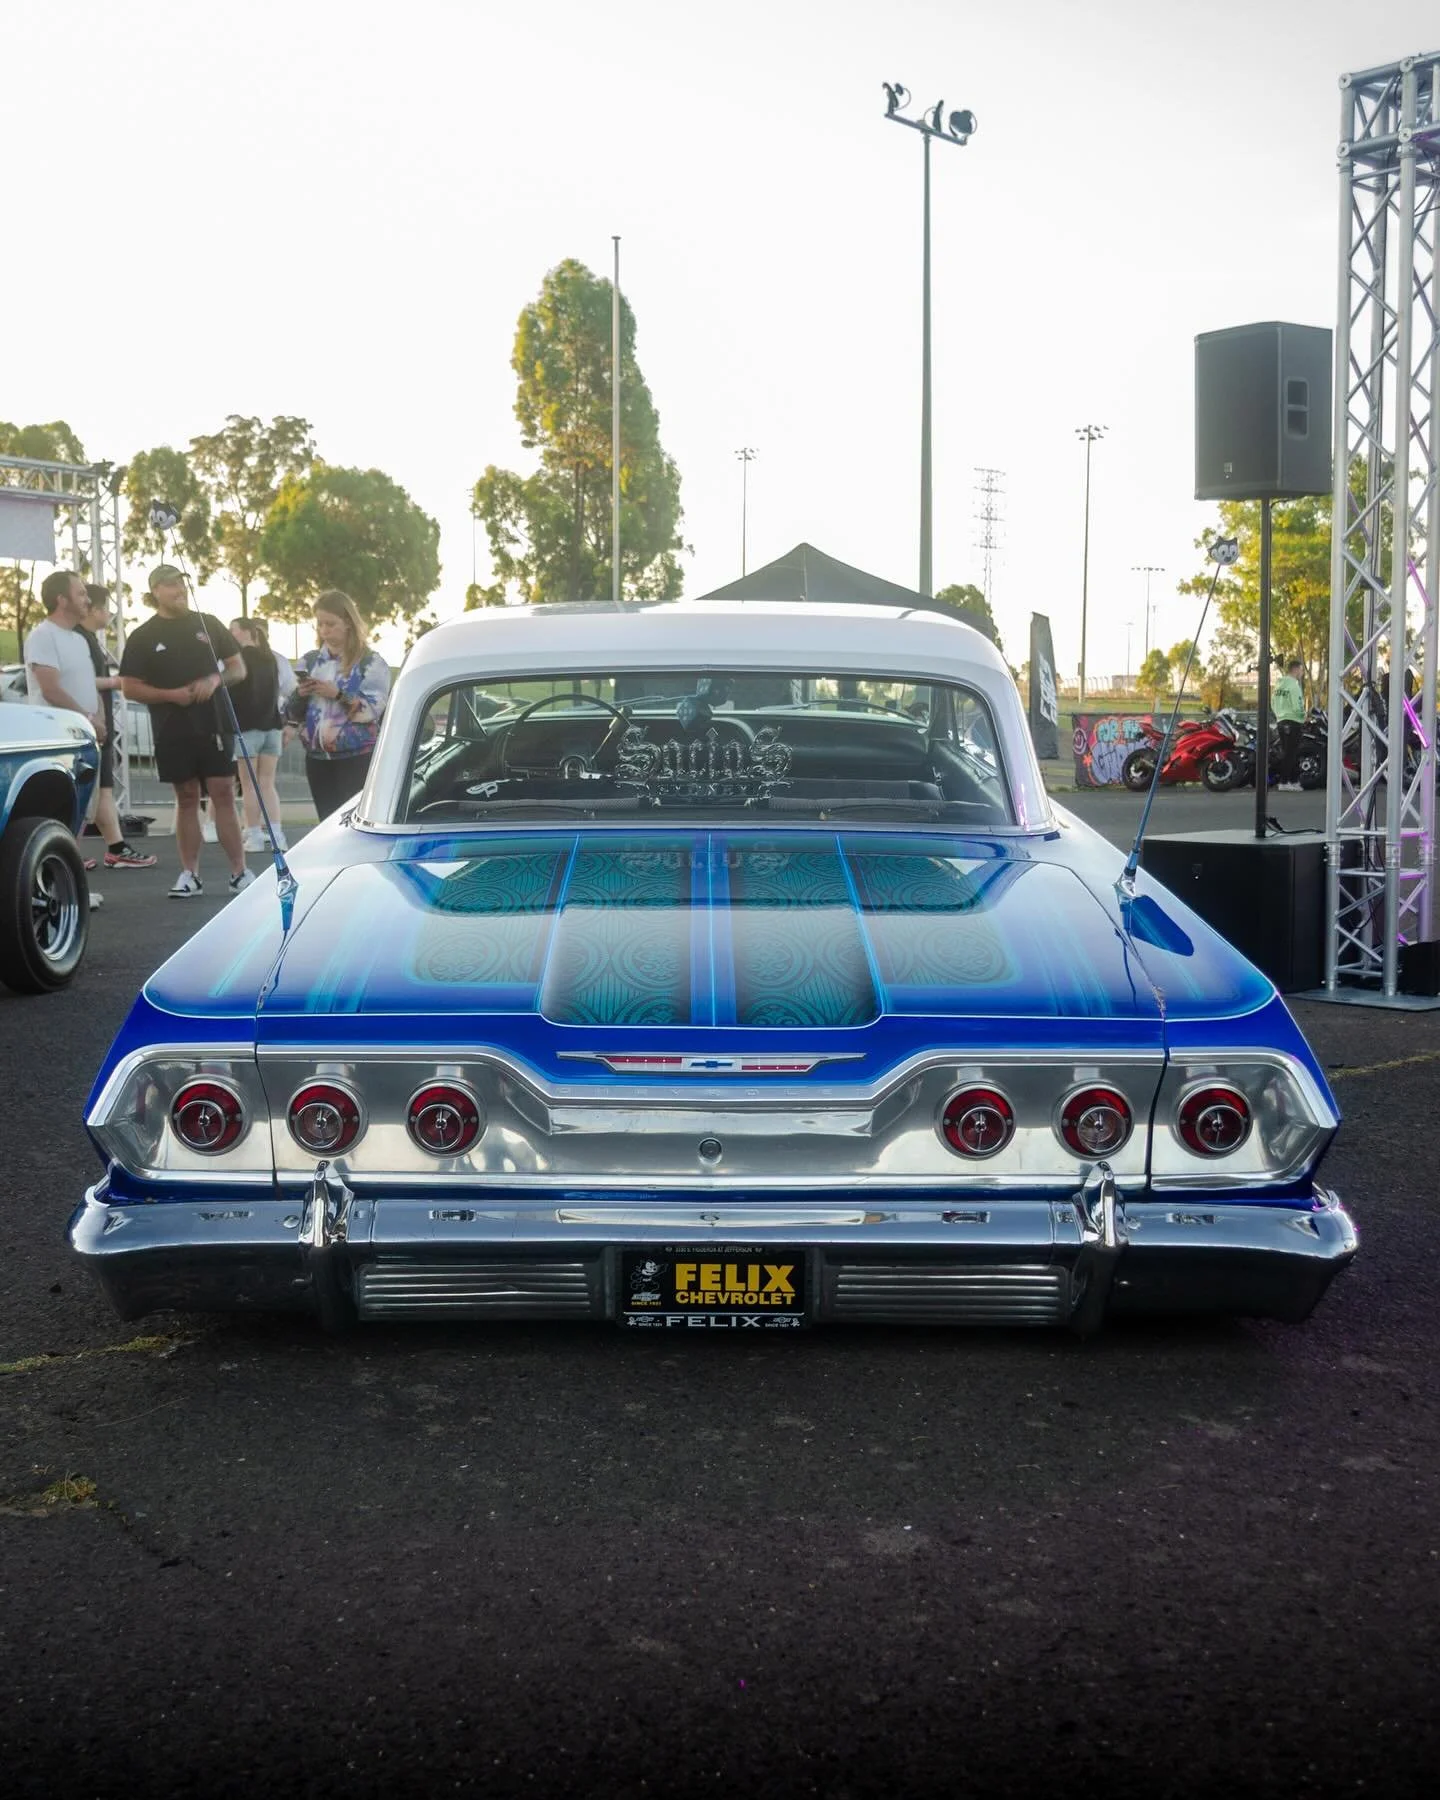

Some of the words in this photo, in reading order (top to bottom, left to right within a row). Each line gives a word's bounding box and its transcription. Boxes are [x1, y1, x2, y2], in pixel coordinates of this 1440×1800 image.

[675, 1263, 795, 1292] FELIX
[675, 1292, 796, 1305] CHEVROLET
[666, 1316, 761, 1327] FELIX
